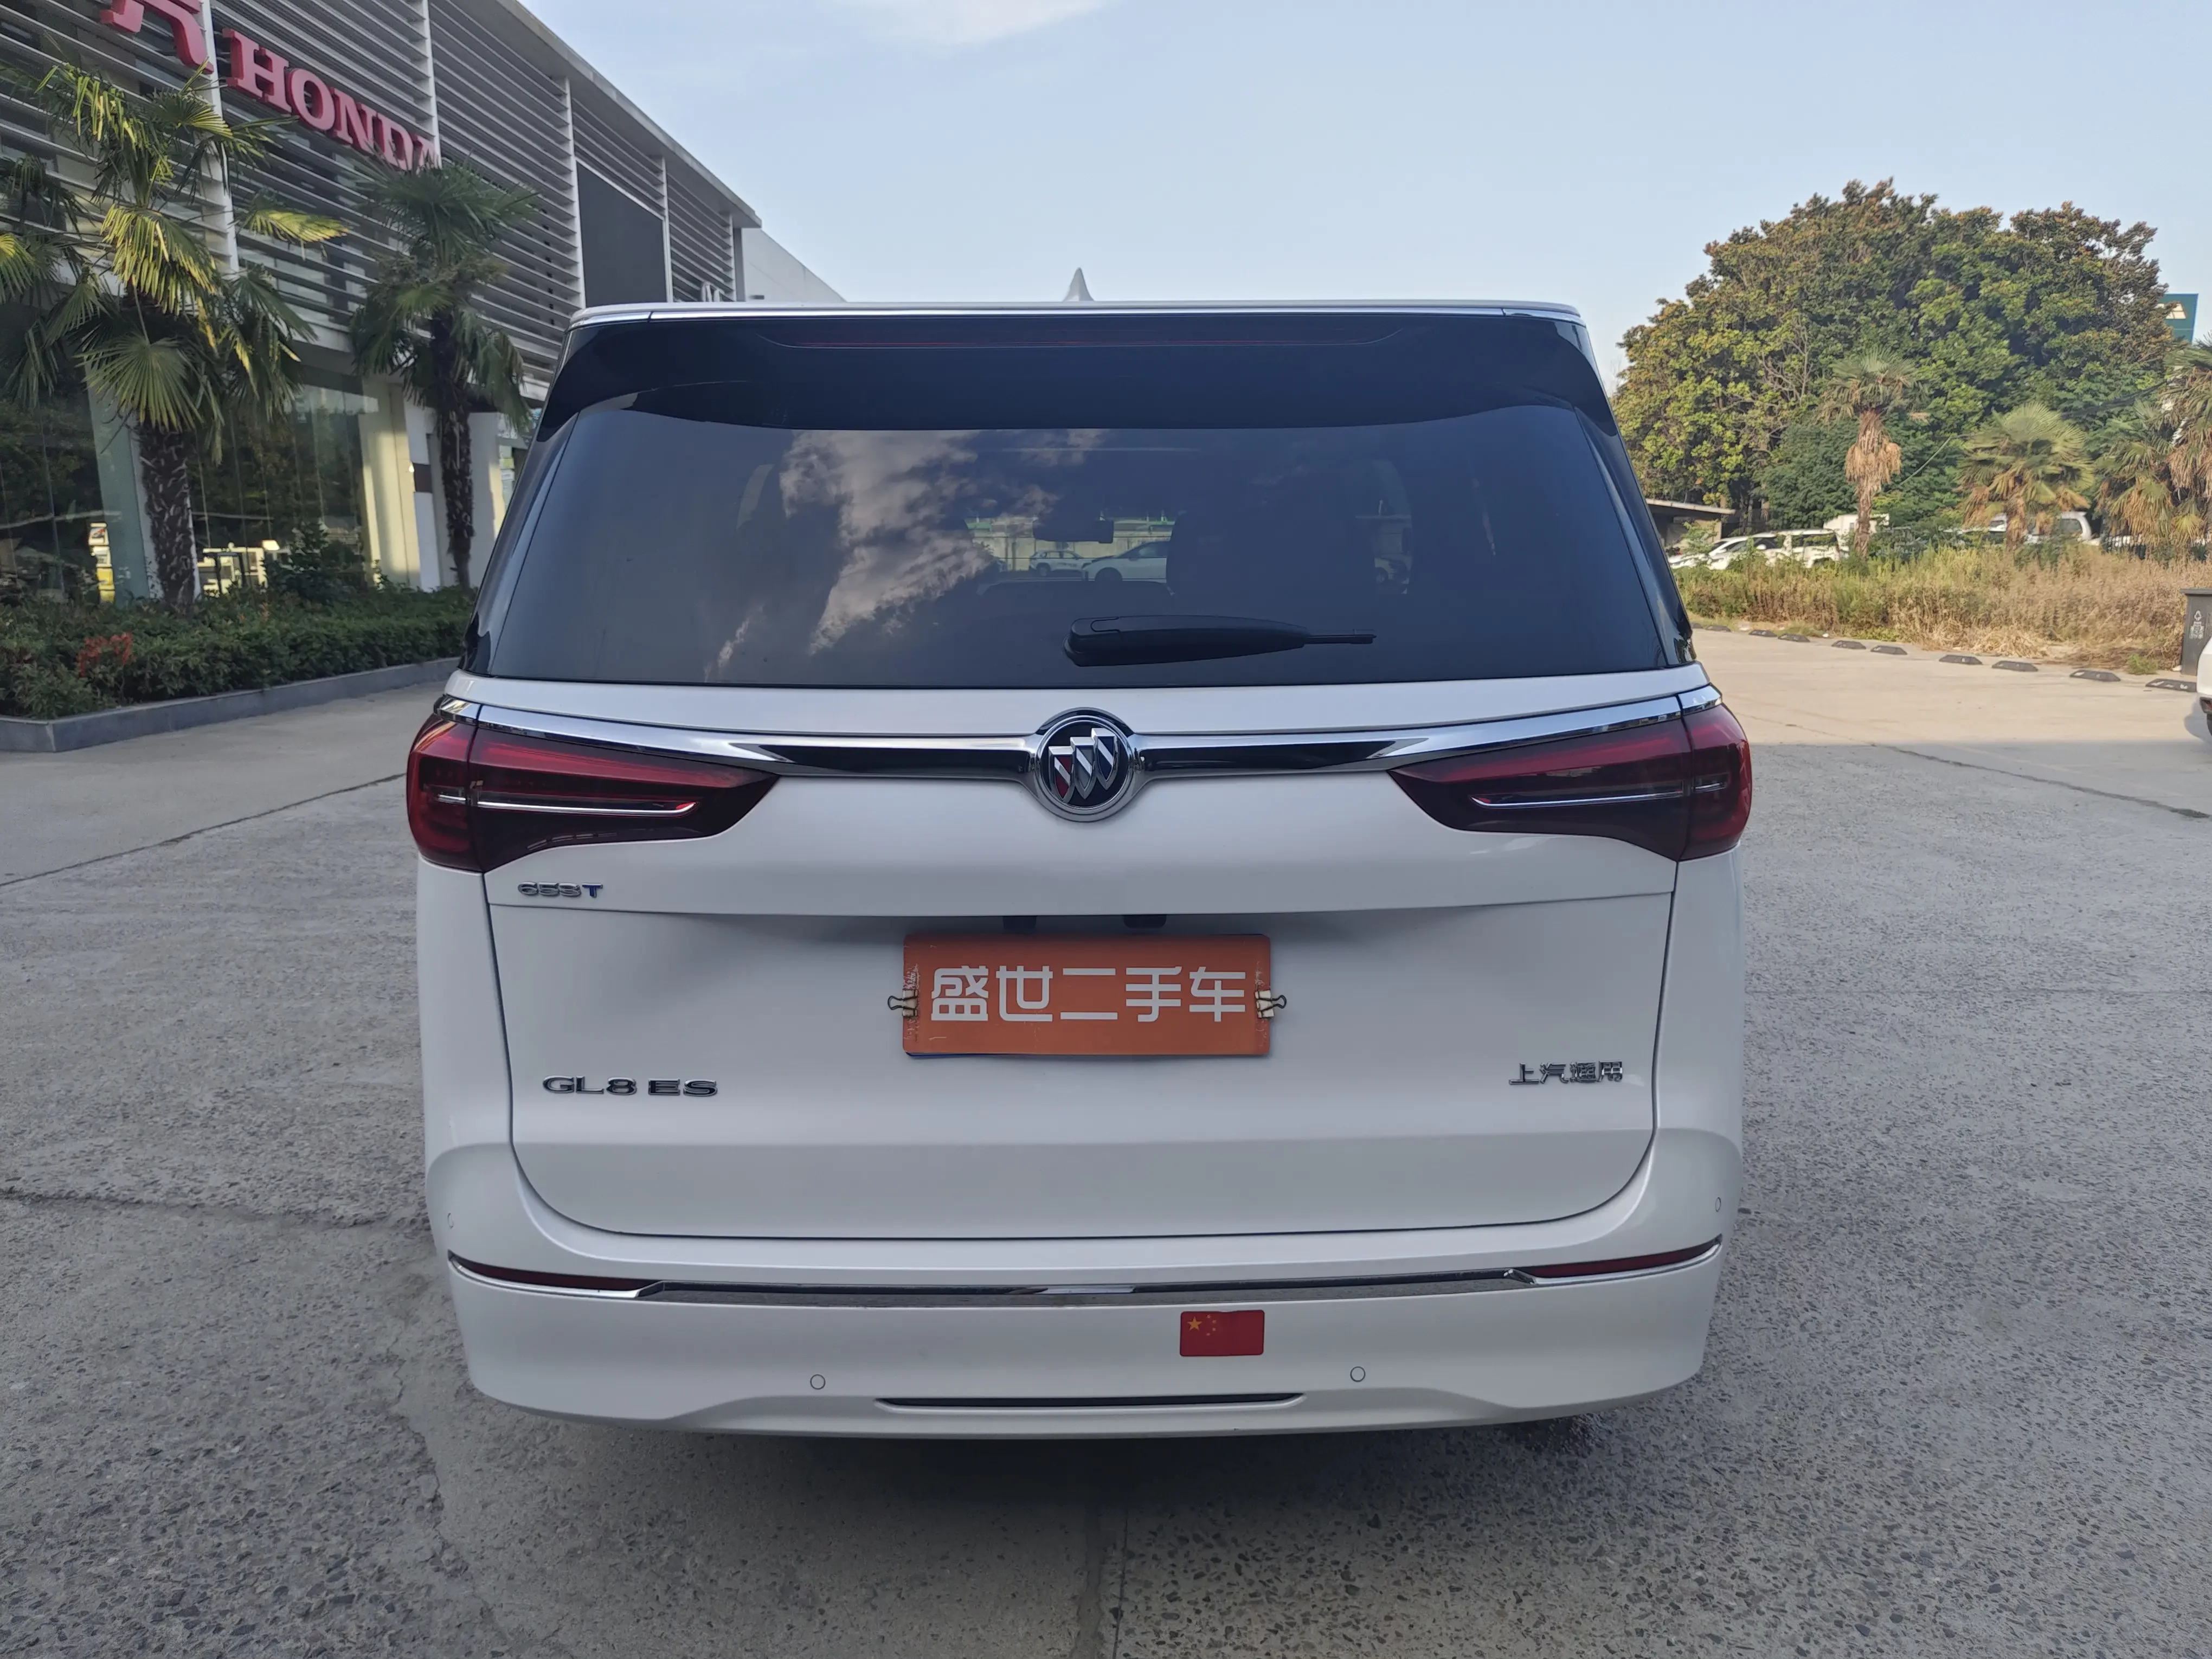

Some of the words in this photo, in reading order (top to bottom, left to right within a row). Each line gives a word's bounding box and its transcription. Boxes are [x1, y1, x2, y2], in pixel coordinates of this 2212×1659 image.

[930, 965, 1246, 1023] 盛世二手车
[1508, 1059, 1623, 1085] 上汽通用
[543, 1075, 638, 1096] GL8
[648, 1078, 718, 1097] ES
